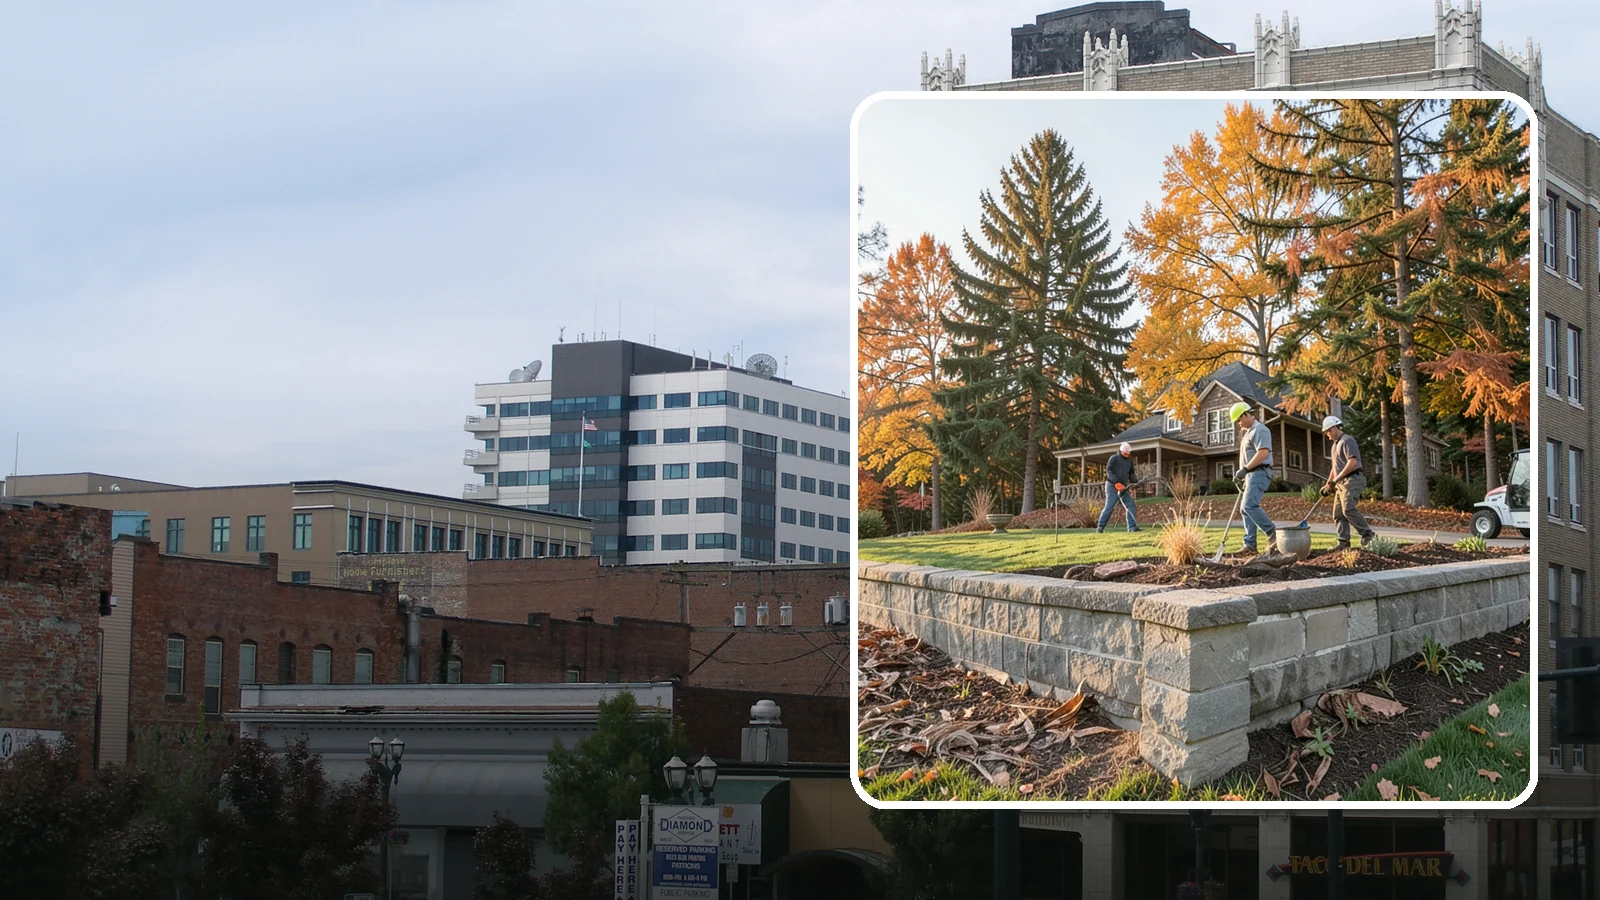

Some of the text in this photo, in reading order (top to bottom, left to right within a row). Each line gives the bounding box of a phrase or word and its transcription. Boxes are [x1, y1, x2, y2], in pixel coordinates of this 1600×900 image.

[660, 818, 713, 833] DIAMOND
[1022, 815, 1069, 827] BUILDING
[656, 845, 716, 854] RESERVED PARKING
[616, 824, 625, 893] PAY HERE
[627, 824, 637, 893] PAY HERE
[671, 862, 701, 870] PATRONS
[1346, 856, 1385, 875] DEL
[1392, 857, 1442, 876] MAR
[660, 888, 710, 898] PUBLIC PARKING
